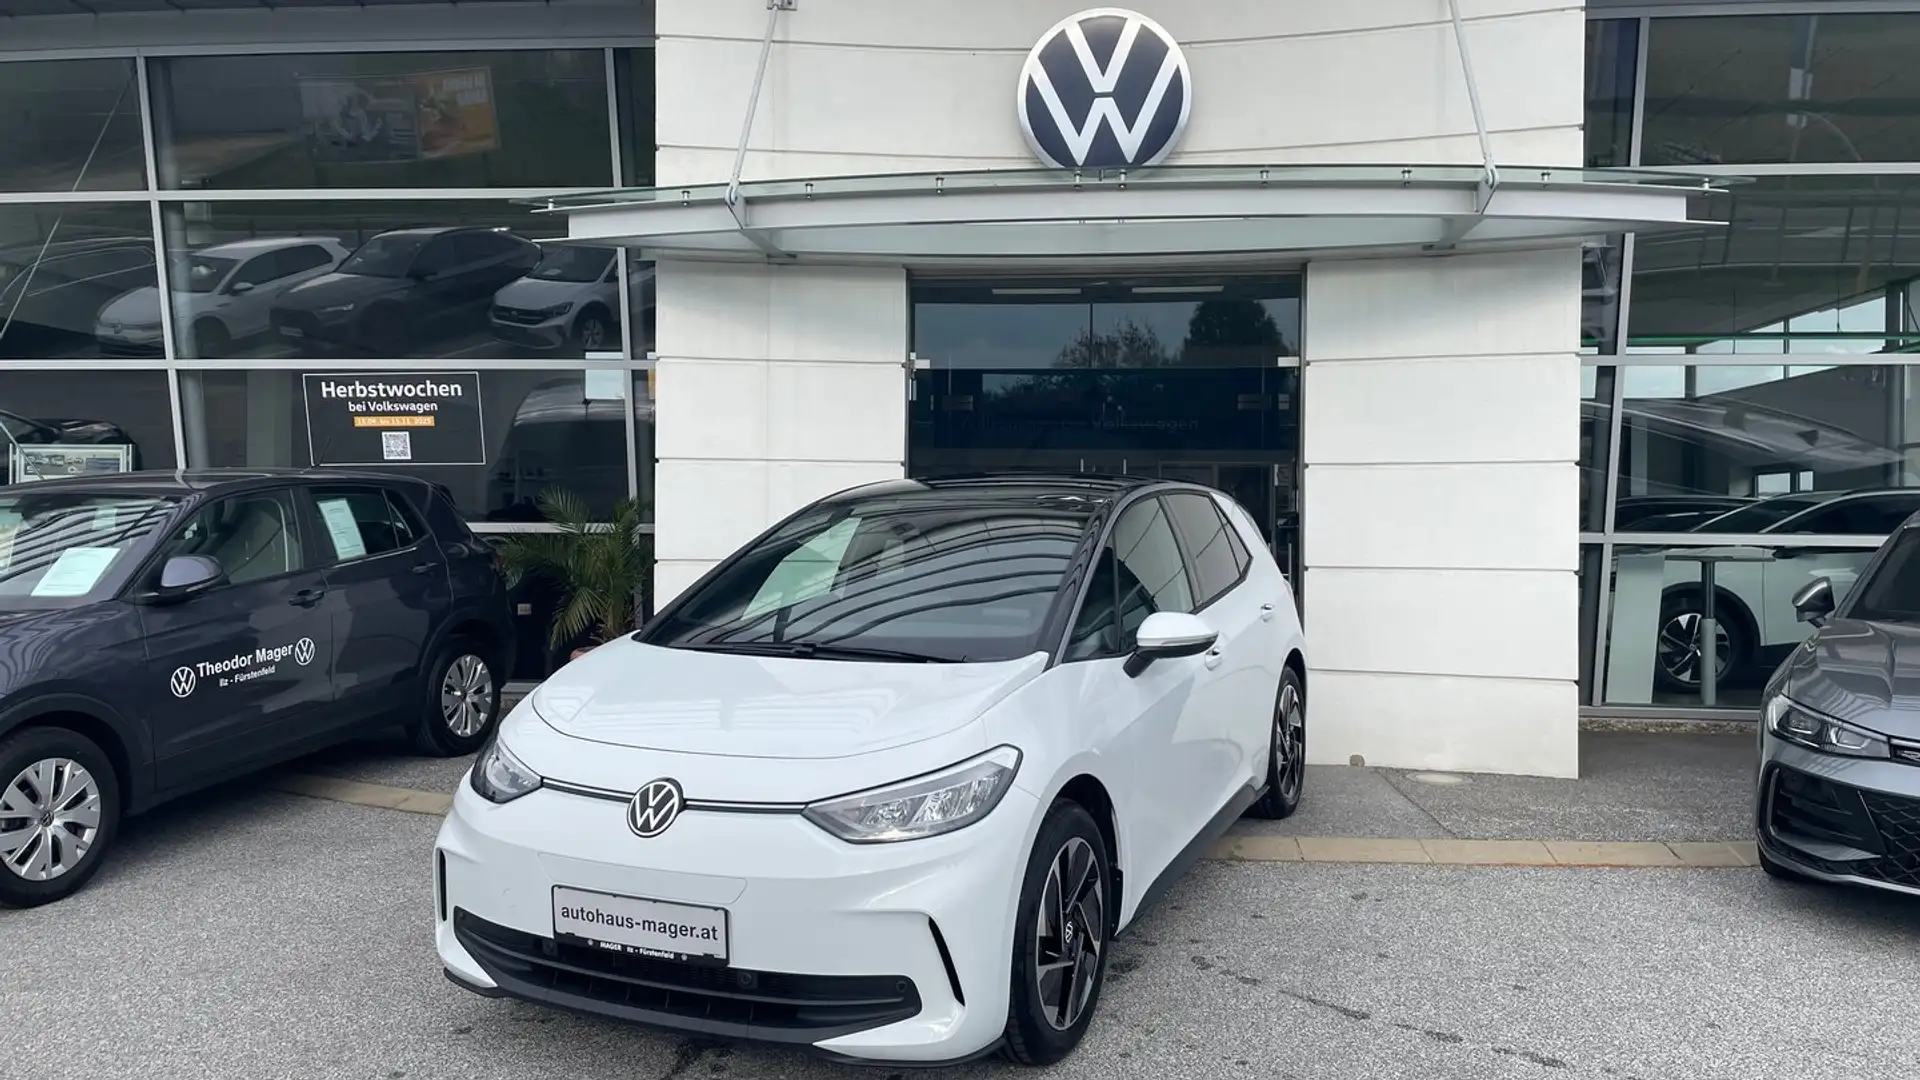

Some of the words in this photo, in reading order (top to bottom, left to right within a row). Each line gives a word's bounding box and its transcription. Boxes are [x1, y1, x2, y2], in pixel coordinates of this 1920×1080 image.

[321, 380, 462, 398] Herbstwochen
[348, 401, 366, 412] bei
[368, 401, 438, 414] Volkswagen
[196, 654, 253, 678] Theodor
[255, 644, 294, 664] Mager
[234, 665, 276, 683] Fürstenfeld
[561, 906, 718, 941] autohaus-mager.at
[600, 941, 622, 951] MAGER
[639, 948, 675, 959] Fürstenfeld
